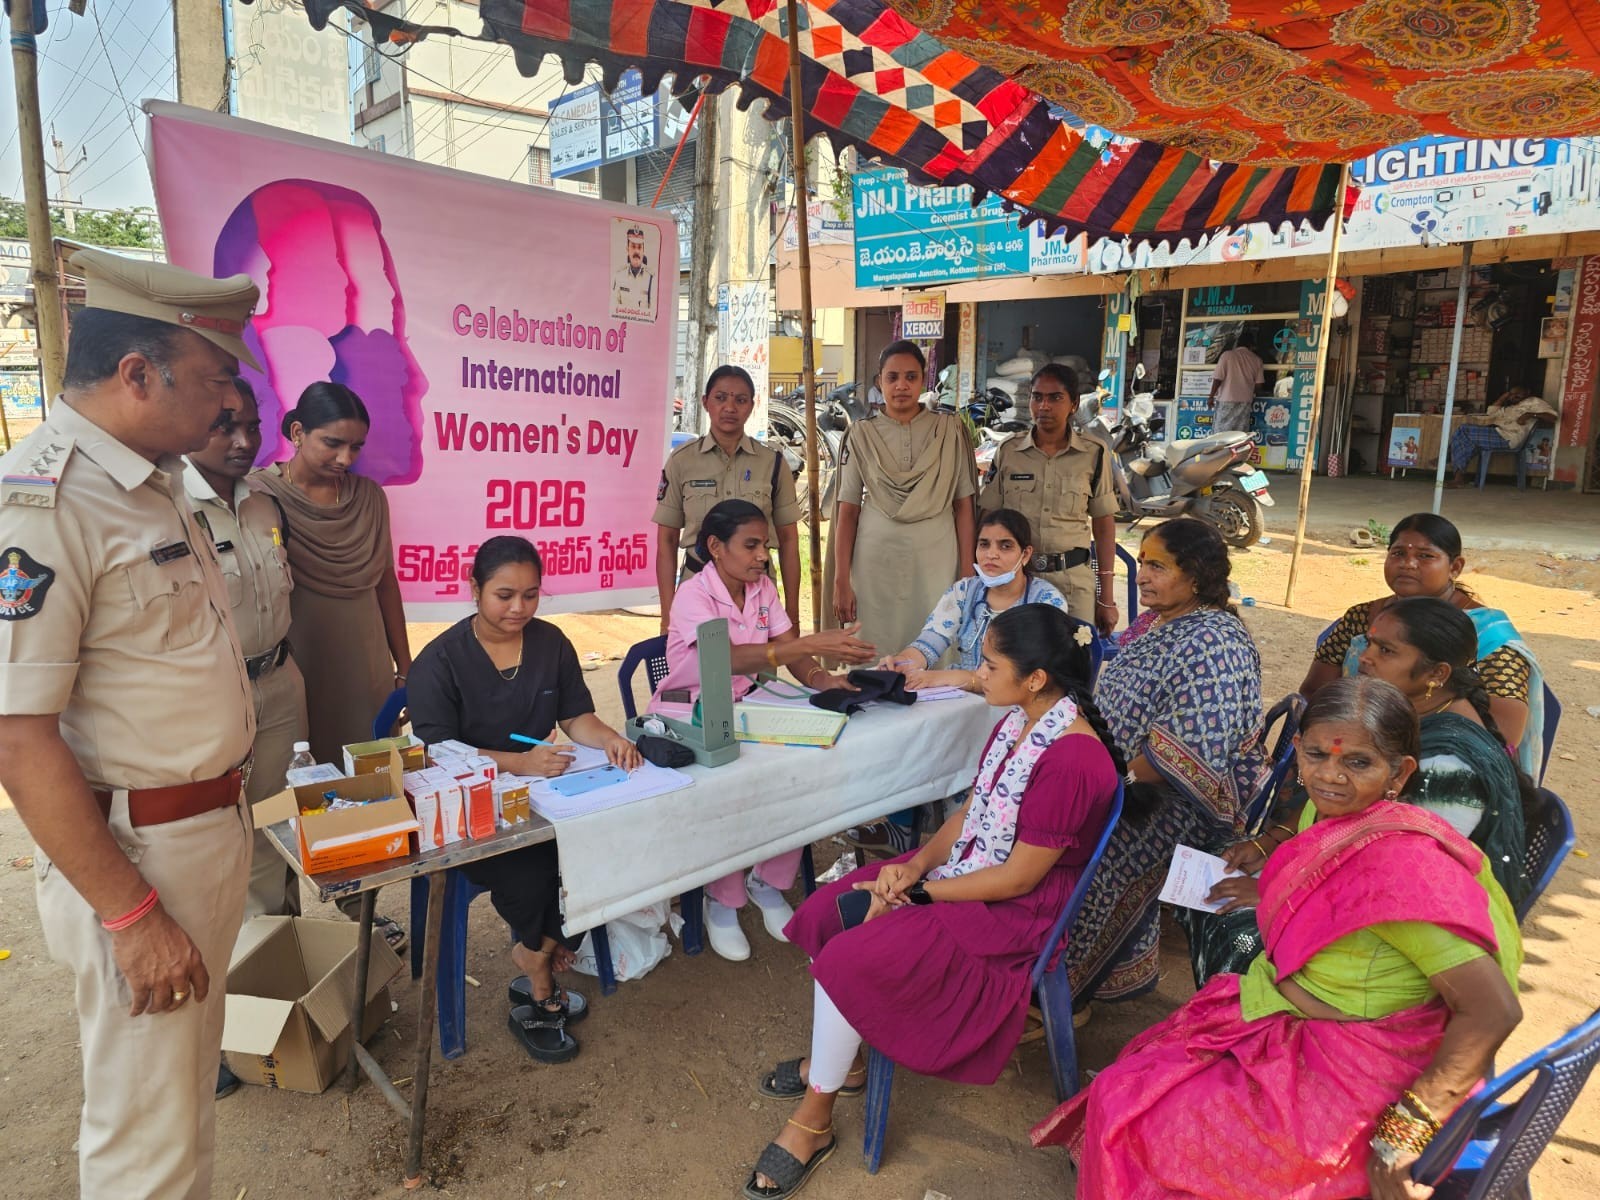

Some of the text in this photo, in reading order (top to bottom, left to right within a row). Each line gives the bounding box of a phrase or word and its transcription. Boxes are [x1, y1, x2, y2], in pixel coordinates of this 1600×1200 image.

[551, 126, 568, 139] SALES
[856, 182, 993, 219] JMJ Pharm
[1390, 195, 1433, 209] Crompton
[930, 207, 1007, 224] Chemist & Drug
[1041, 240, 1070, 257] JMJ
[1031, 254, 1078, 267] Pharmacy
[1207, 304, 1254, 315] PHARMACY
[452, 303, 627, 353] Celebration of
[905, 321, 941, 336] XEROX
[462, 356, 621, 399] International
[434, 411, 639, 468] Women's Day
[485, 478, 586, 530] 2026
[597, 531, 648, 589] స్టేషన్
